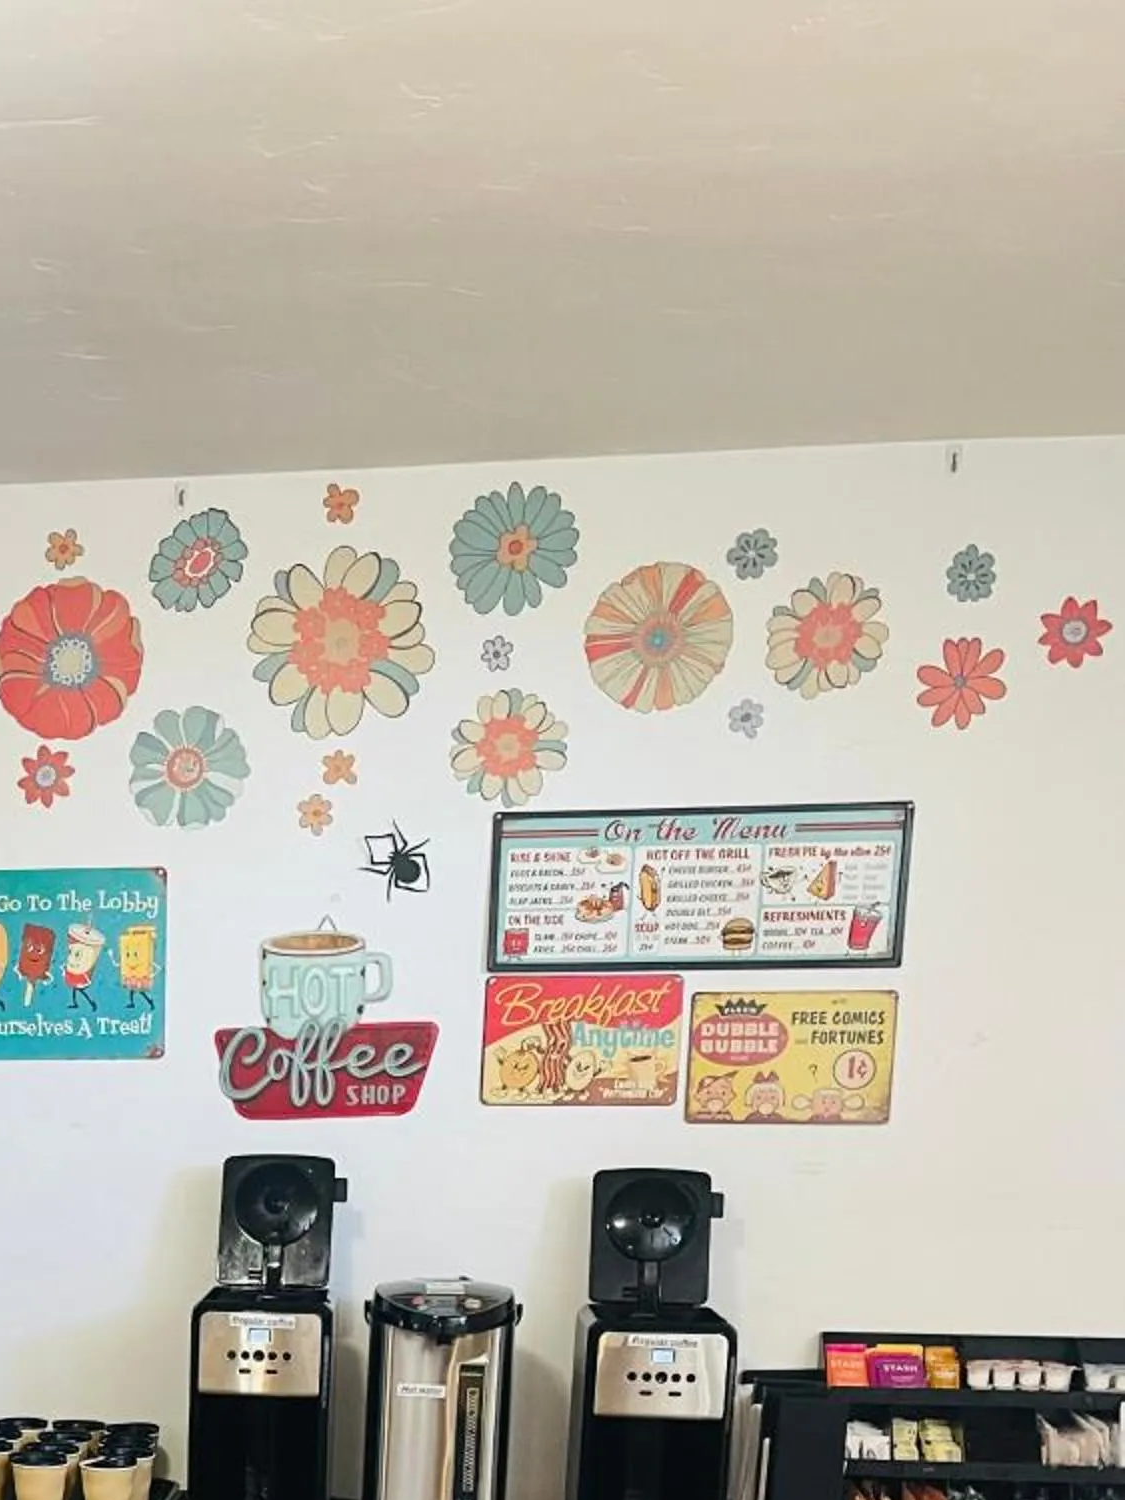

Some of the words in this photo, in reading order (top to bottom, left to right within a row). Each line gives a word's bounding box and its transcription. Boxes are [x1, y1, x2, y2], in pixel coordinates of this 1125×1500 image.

[604, 820, 642, 842] On
[648, 818, 697, 841] the
[713, 817, 786, 840] Menu
[27, 894, 52, 912] To
[58, 889, 92, 912] The
[98, 889, 158, 918] Lobby
[266, 964, 356, 1018] HOT
[495, 981, 672, 1027] Breakfast
[77, 1018, 93, 1039] A
[96, 1013, 152, 1036] Treat!
[700, 1022, 779, 1037] DUBBLE
[791, 1011, 827, 1025] FREE
[832, 1010, 885, 1025] COMICS
[571, 1019, 675, 1058] Anytime
[700, 1039, 778, 1054] BUBBLE
[810, 1029, 884, 1045] FORTUNES
[219, 1018, 427, 1107] Coffee
[847, 1055, 868, 1079] 1¢
[345, 1084, 406, 1106] SHOP
[882, 1363, 918, 1373] STASH
